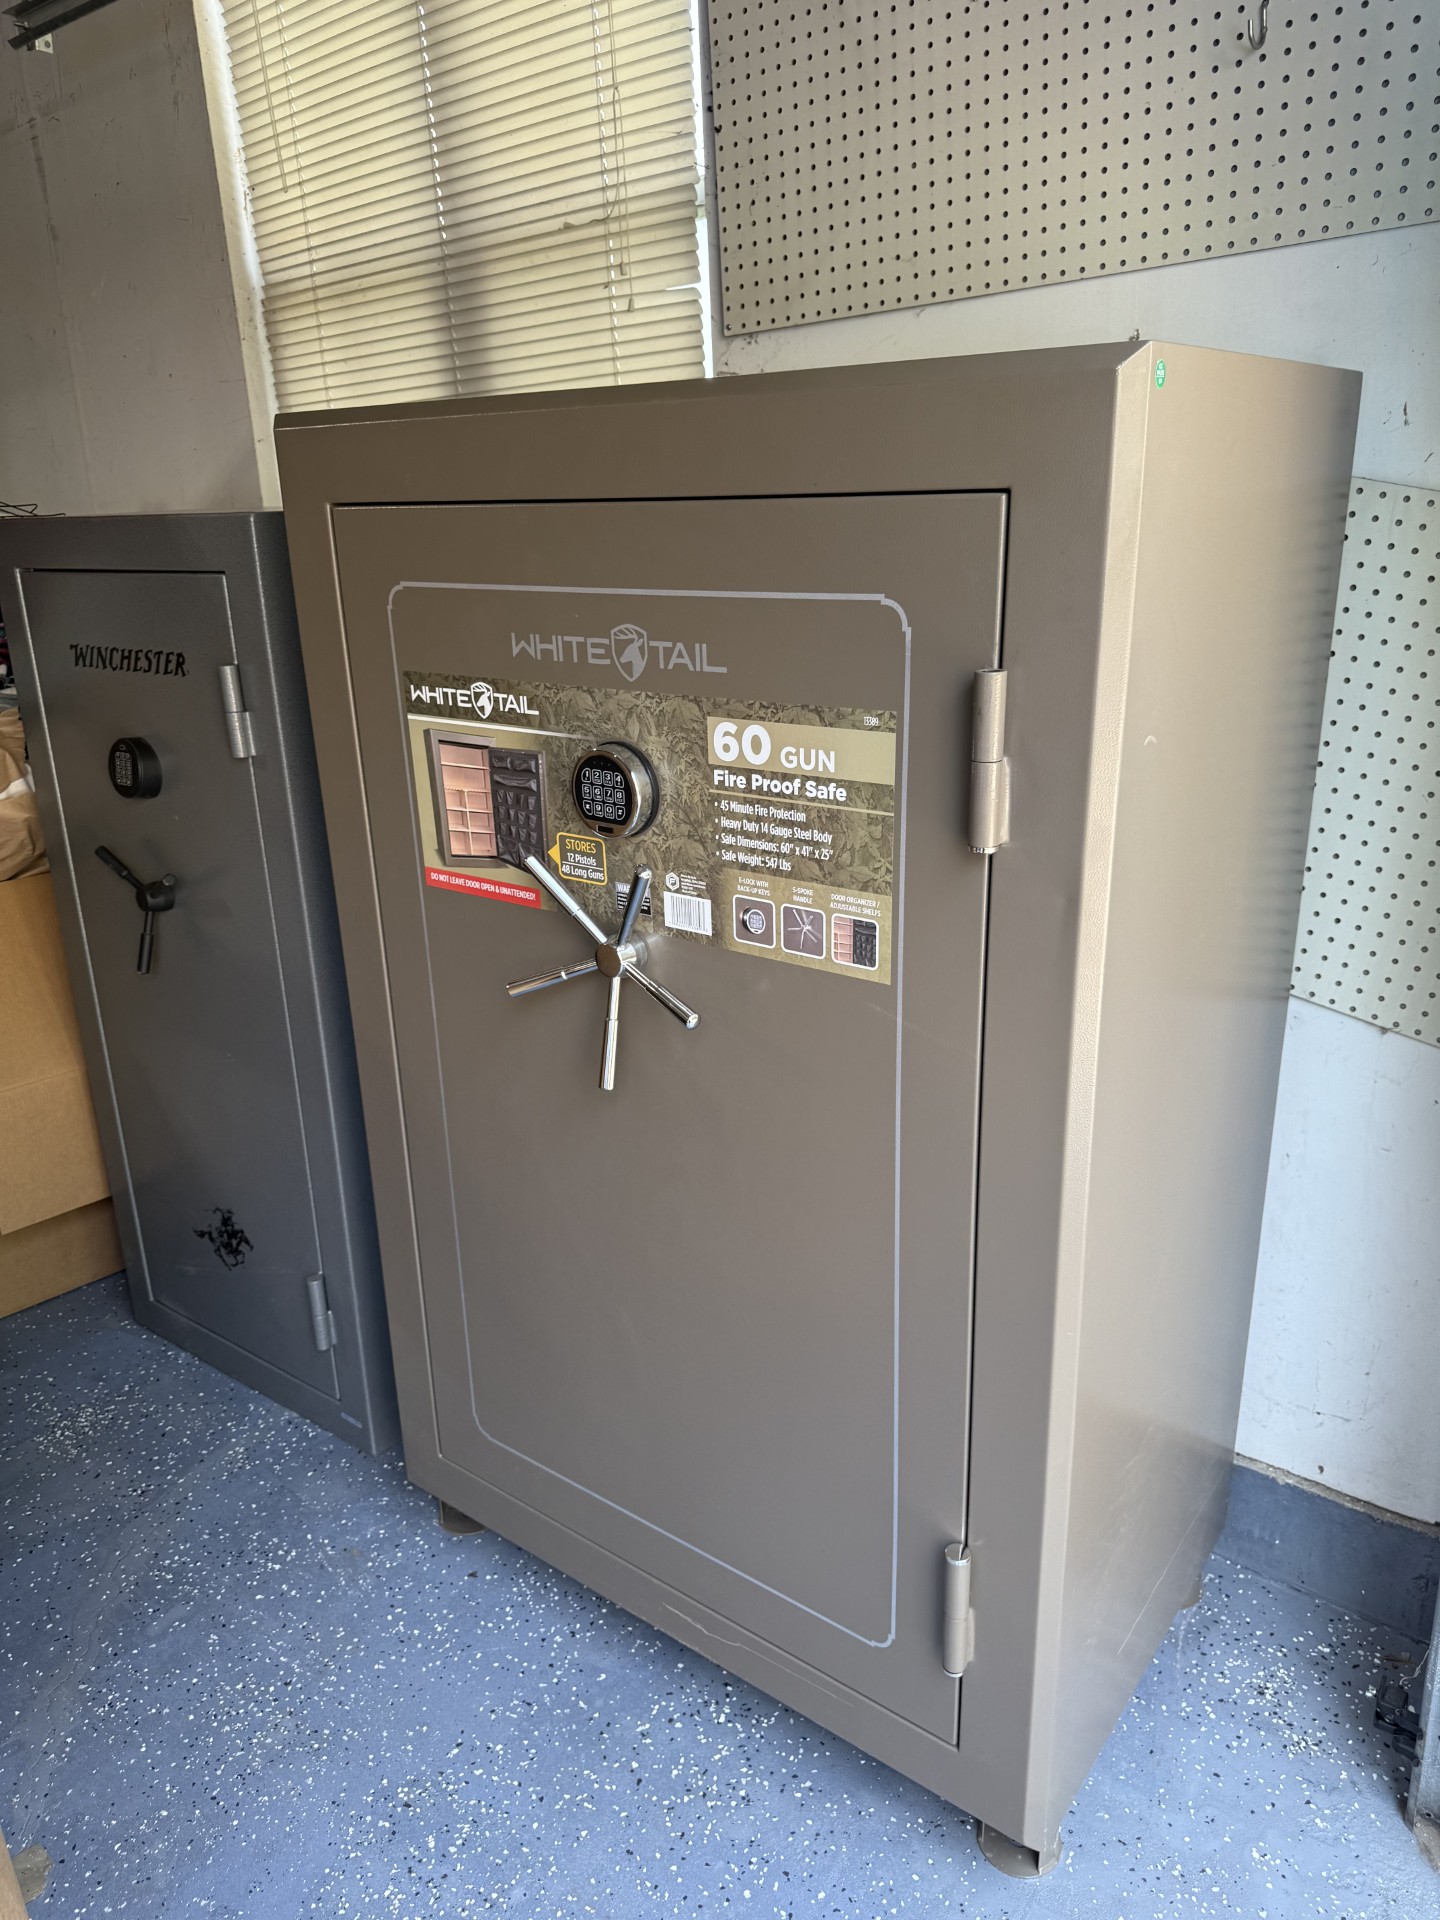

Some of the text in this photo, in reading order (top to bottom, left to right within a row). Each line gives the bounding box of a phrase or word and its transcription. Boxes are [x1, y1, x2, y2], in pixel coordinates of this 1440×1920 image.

[69, 643, 187, 677] WINCHESTER
[511, 632, 728, 674] WHITE TAIL
[410, 685, 539, 716] WHITE TAIL
[713, 721, 836, 773] 60 GUN
[713, 769, 847, 801] Fire Proof Safe
[720, 799, 806, 822] 45 Minute Fire Protection
[721, 816, 832, 845] Heavy Duty 14 Gauge Steel Body
[566, 839, 597, 854] STORES
[721, 833, 834, 861] Safe Dimensions: 60" x 41" x 25"
[567, 853, 597, 866] 12 Pistols
[722, 850, 792, 872] Safe Weight: 547 Lbs
[562, 865, 604, 881] 48 Long Guns
[738, 877, 769, 888] E-LOCK WITH
[431, 872, 439, 881] DO
[439, 874, 449, 882] NOT
[450, 875, 465, 886] LEAVE
[466, 879, 480, 889] DOOR
[481, 882, 495, 892] OPEN
[500, 886, 536, 901] UNATTENDED!
[737, 885, 758, 894] BACK-UP
[792, 887, 814, 896] 5-SPOKE
[793, 895, 812, 904] HANDLE
[830, 902, 862, 915] ADJUSTABLE
[831, 894, 846, 902] DOOR
[847, 896, 876, 907] ORGANIZER
